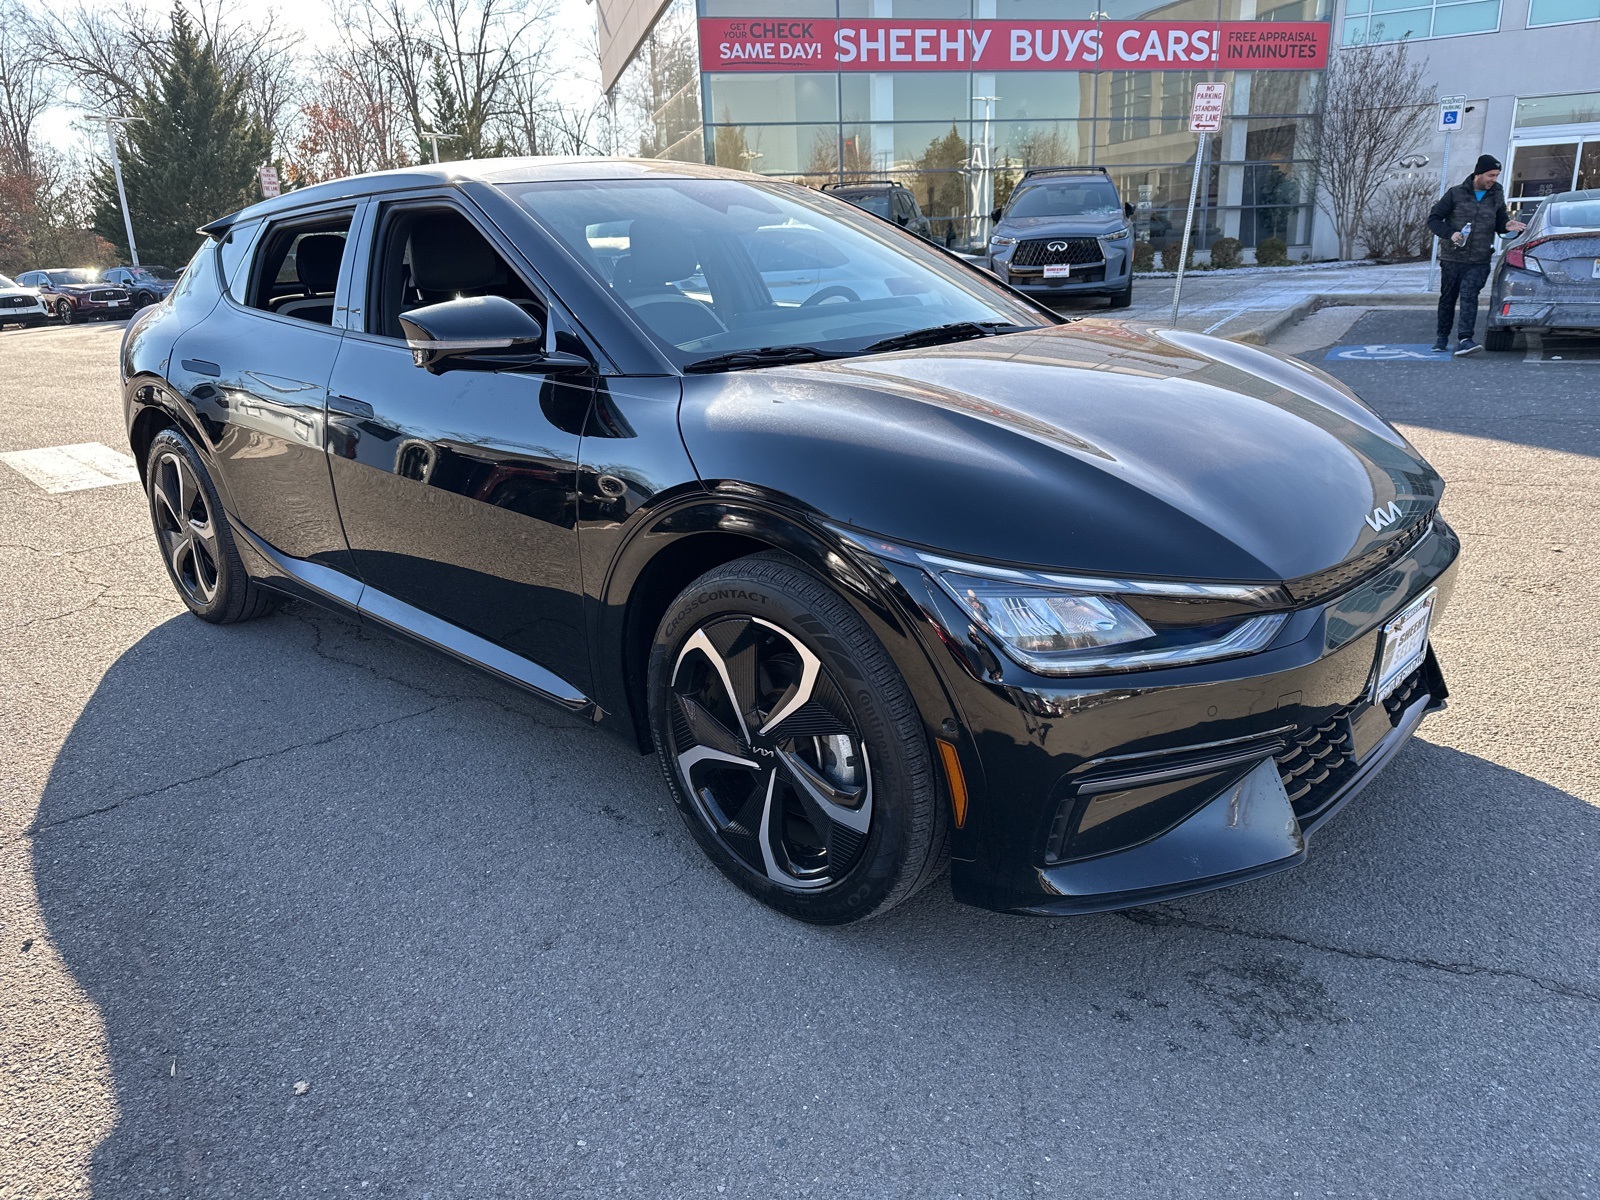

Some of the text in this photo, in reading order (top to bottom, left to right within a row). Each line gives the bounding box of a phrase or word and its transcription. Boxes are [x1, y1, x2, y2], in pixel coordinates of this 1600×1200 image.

[730, 23, 747, 31] GET
[749, 22, 814, 39] CHECK
[723, 31, 747, 39] YOUR
[1229, 32, 1318, 42] FREE APPRAISAL
[719, 42, 822, 59] SAME DAY!
[833, 28, 1220, 62] SHEEHY BUYS CARS!
[1227, 45, 1317, 59] IN MINUTES
[1398, 612, 1429, 647] SHEEHY
